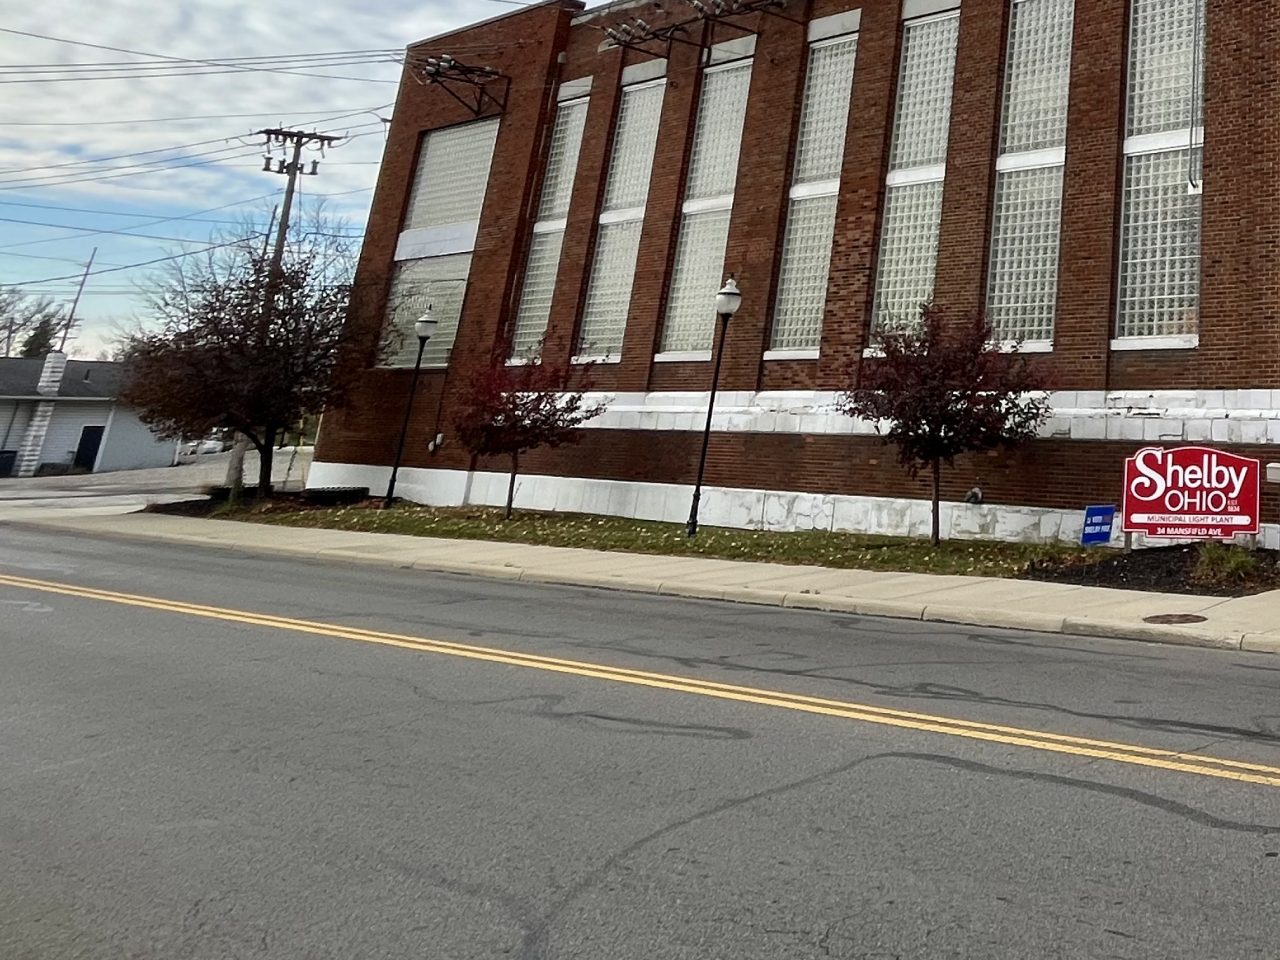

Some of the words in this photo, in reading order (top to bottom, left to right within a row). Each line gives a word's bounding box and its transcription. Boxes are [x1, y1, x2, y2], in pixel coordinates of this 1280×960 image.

[1130, 449, 1248, 501] Shelby
[1164, 490, 1227, 512] OHIO
[1146, 515, 1187, 523] MUNICIPAL
[1188, 515, 1210, 524] LIGHT
[1211, 516, 1234, 524] PLANT
[1156, 527, 1165, 535] 34
[1166, 527, 1207, 536] MANSFIELD
